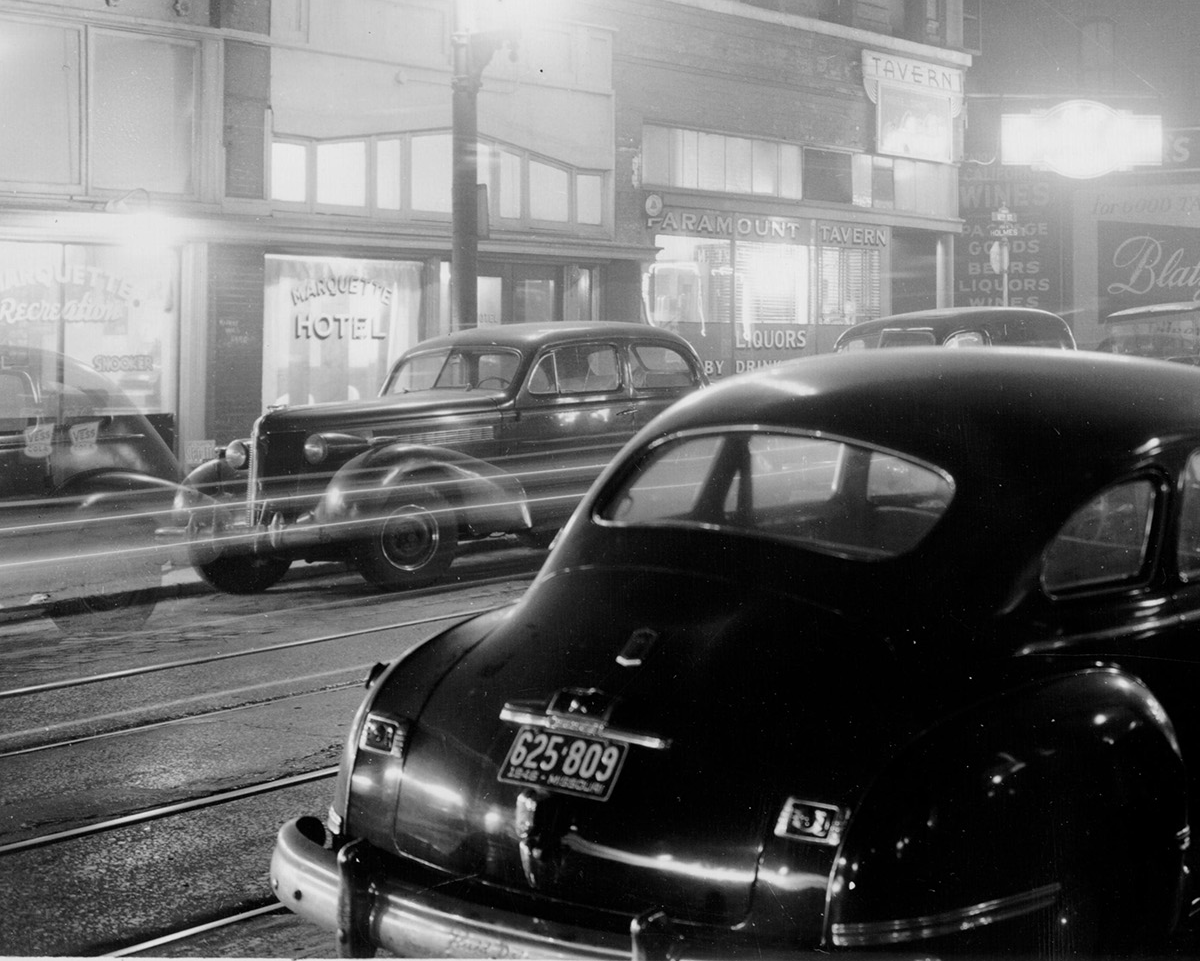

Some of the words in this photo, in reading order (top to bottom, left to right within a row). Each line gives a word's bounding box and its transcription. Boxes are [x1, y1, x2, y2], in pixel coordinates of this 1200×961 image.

[872, 56, 953, 90] TAVERN
[960, 182, 1050, 208] WINES
[819, 224, 888, 247] TAVERN
[968, 240, 1040, 256] GODS
[968, 261, 1040, 276] BERS
[290, 274, 393, 307] MARQUETTE
[959, 278, 1050, 294] LIQUORS
[0, 291, 122, 324] Recreation
[969, 296, 1039, 308] WINES
[294, 312, 388, 341] HOTEL
[735, 329, 807, 350] LIQUORS
[705, 360, 724, 374] BY
[72, 427, 96, 442] VESS
